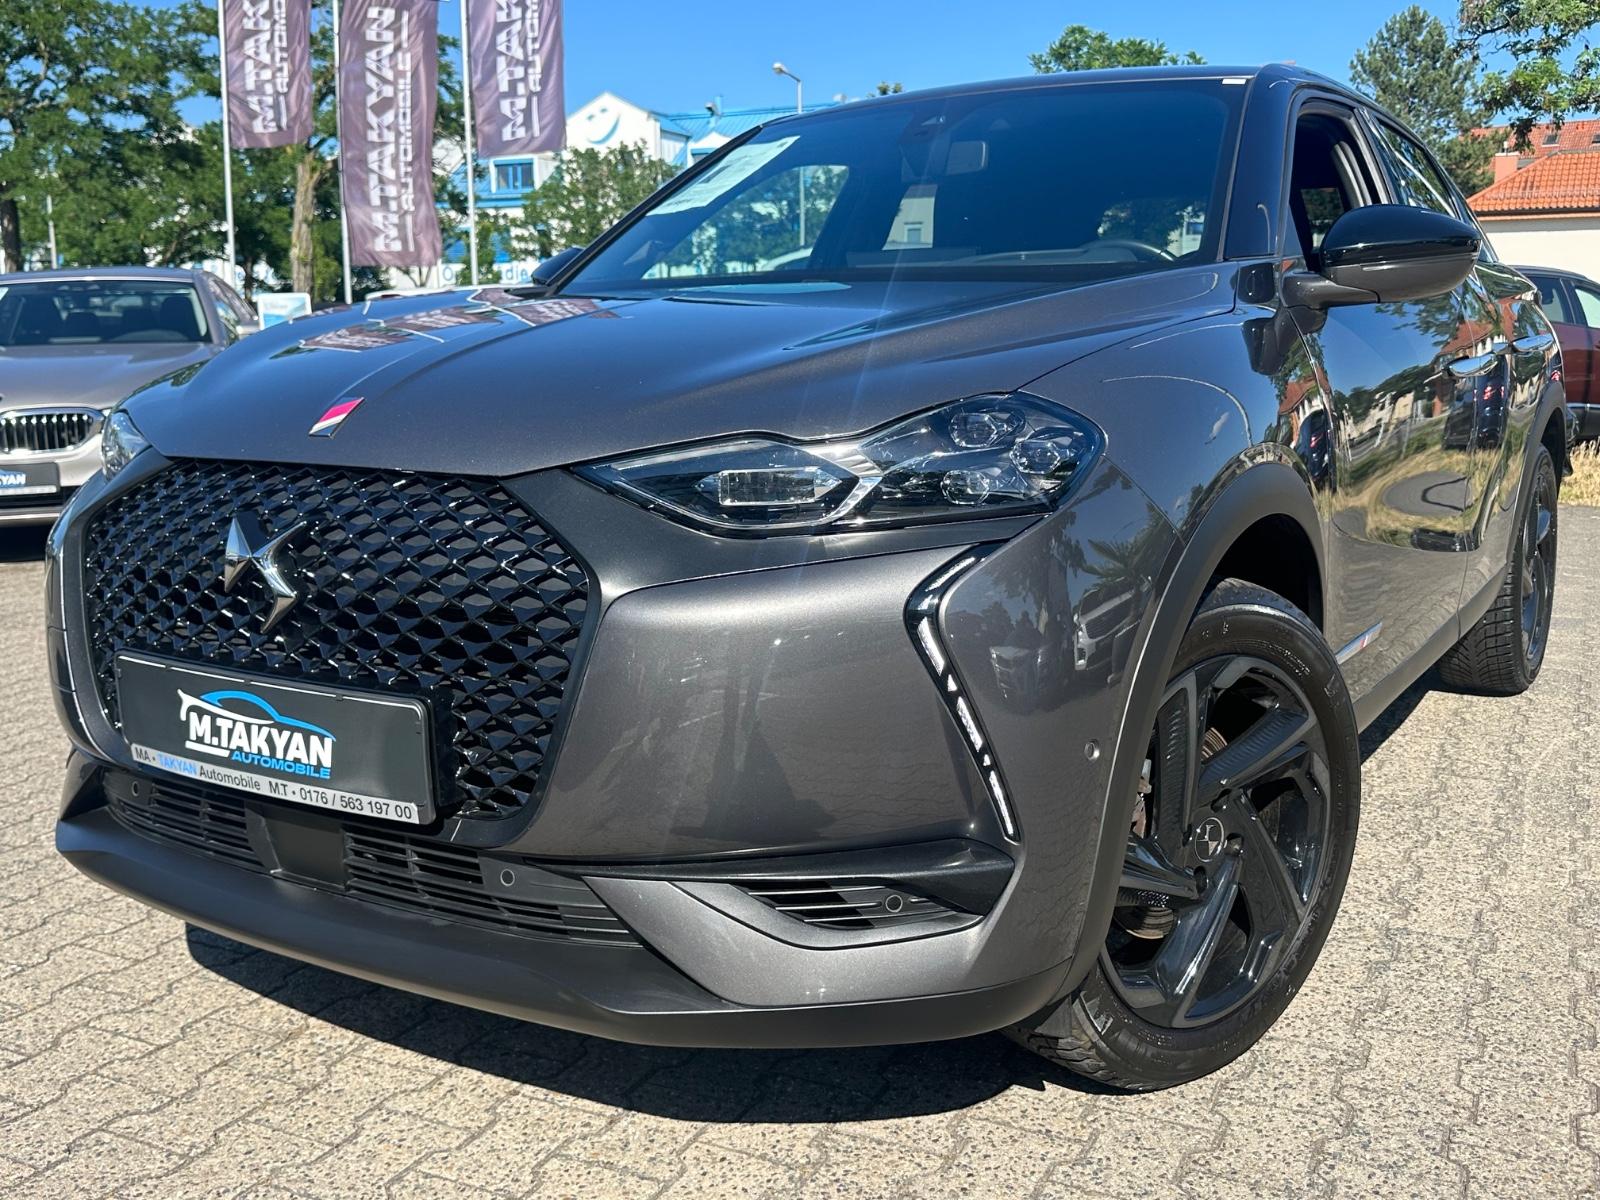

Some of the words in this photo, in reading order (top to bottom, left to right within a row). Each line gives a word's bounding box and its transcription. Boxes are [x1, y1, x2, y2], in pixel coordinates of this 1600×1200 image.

[365, 6, 402, 252] M.TAKYAN
[397, 51, 415, 211] AUTOMOBILE
[0, 472, 26, 485] YAN
[189, 711, 334, 768] M.TAKYAN
[231, 750, 331, 779] AUTOMOBILE
[158, 752, 198, 776] TAKYAN
[199, 765, 261, 791] Automobile
[299, 787, 328, 805] 0176
[340, 795, 364, 811] 563
[367, 800, 390, 816] 197
[394, 804, 412, 819] 00
